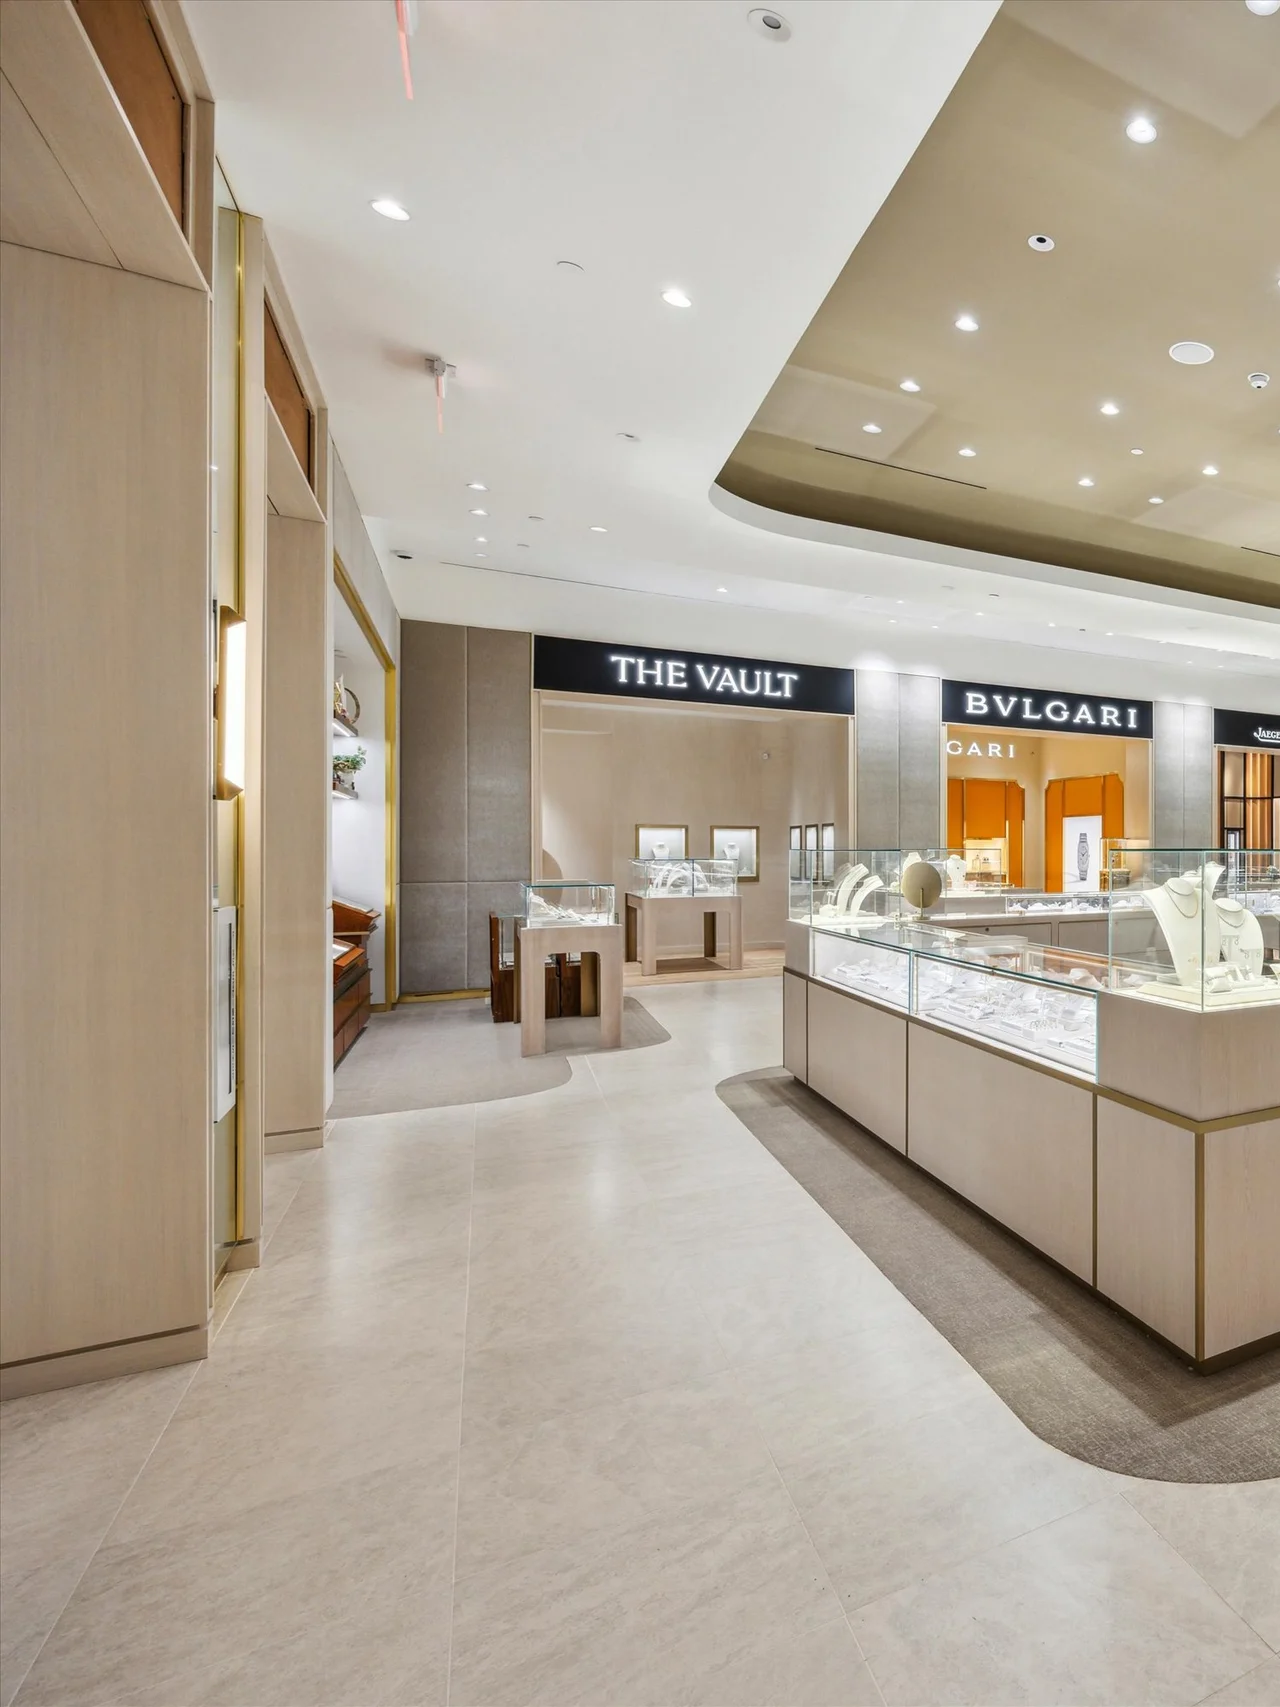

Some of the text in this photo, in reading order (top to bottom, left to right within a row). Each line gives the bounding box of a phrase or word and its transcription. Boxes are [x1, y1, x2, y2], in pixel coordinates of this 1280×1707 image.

[610, 655, 799, 698] THE VAULT
[965, 692, 1138, 728] BVLGARI
